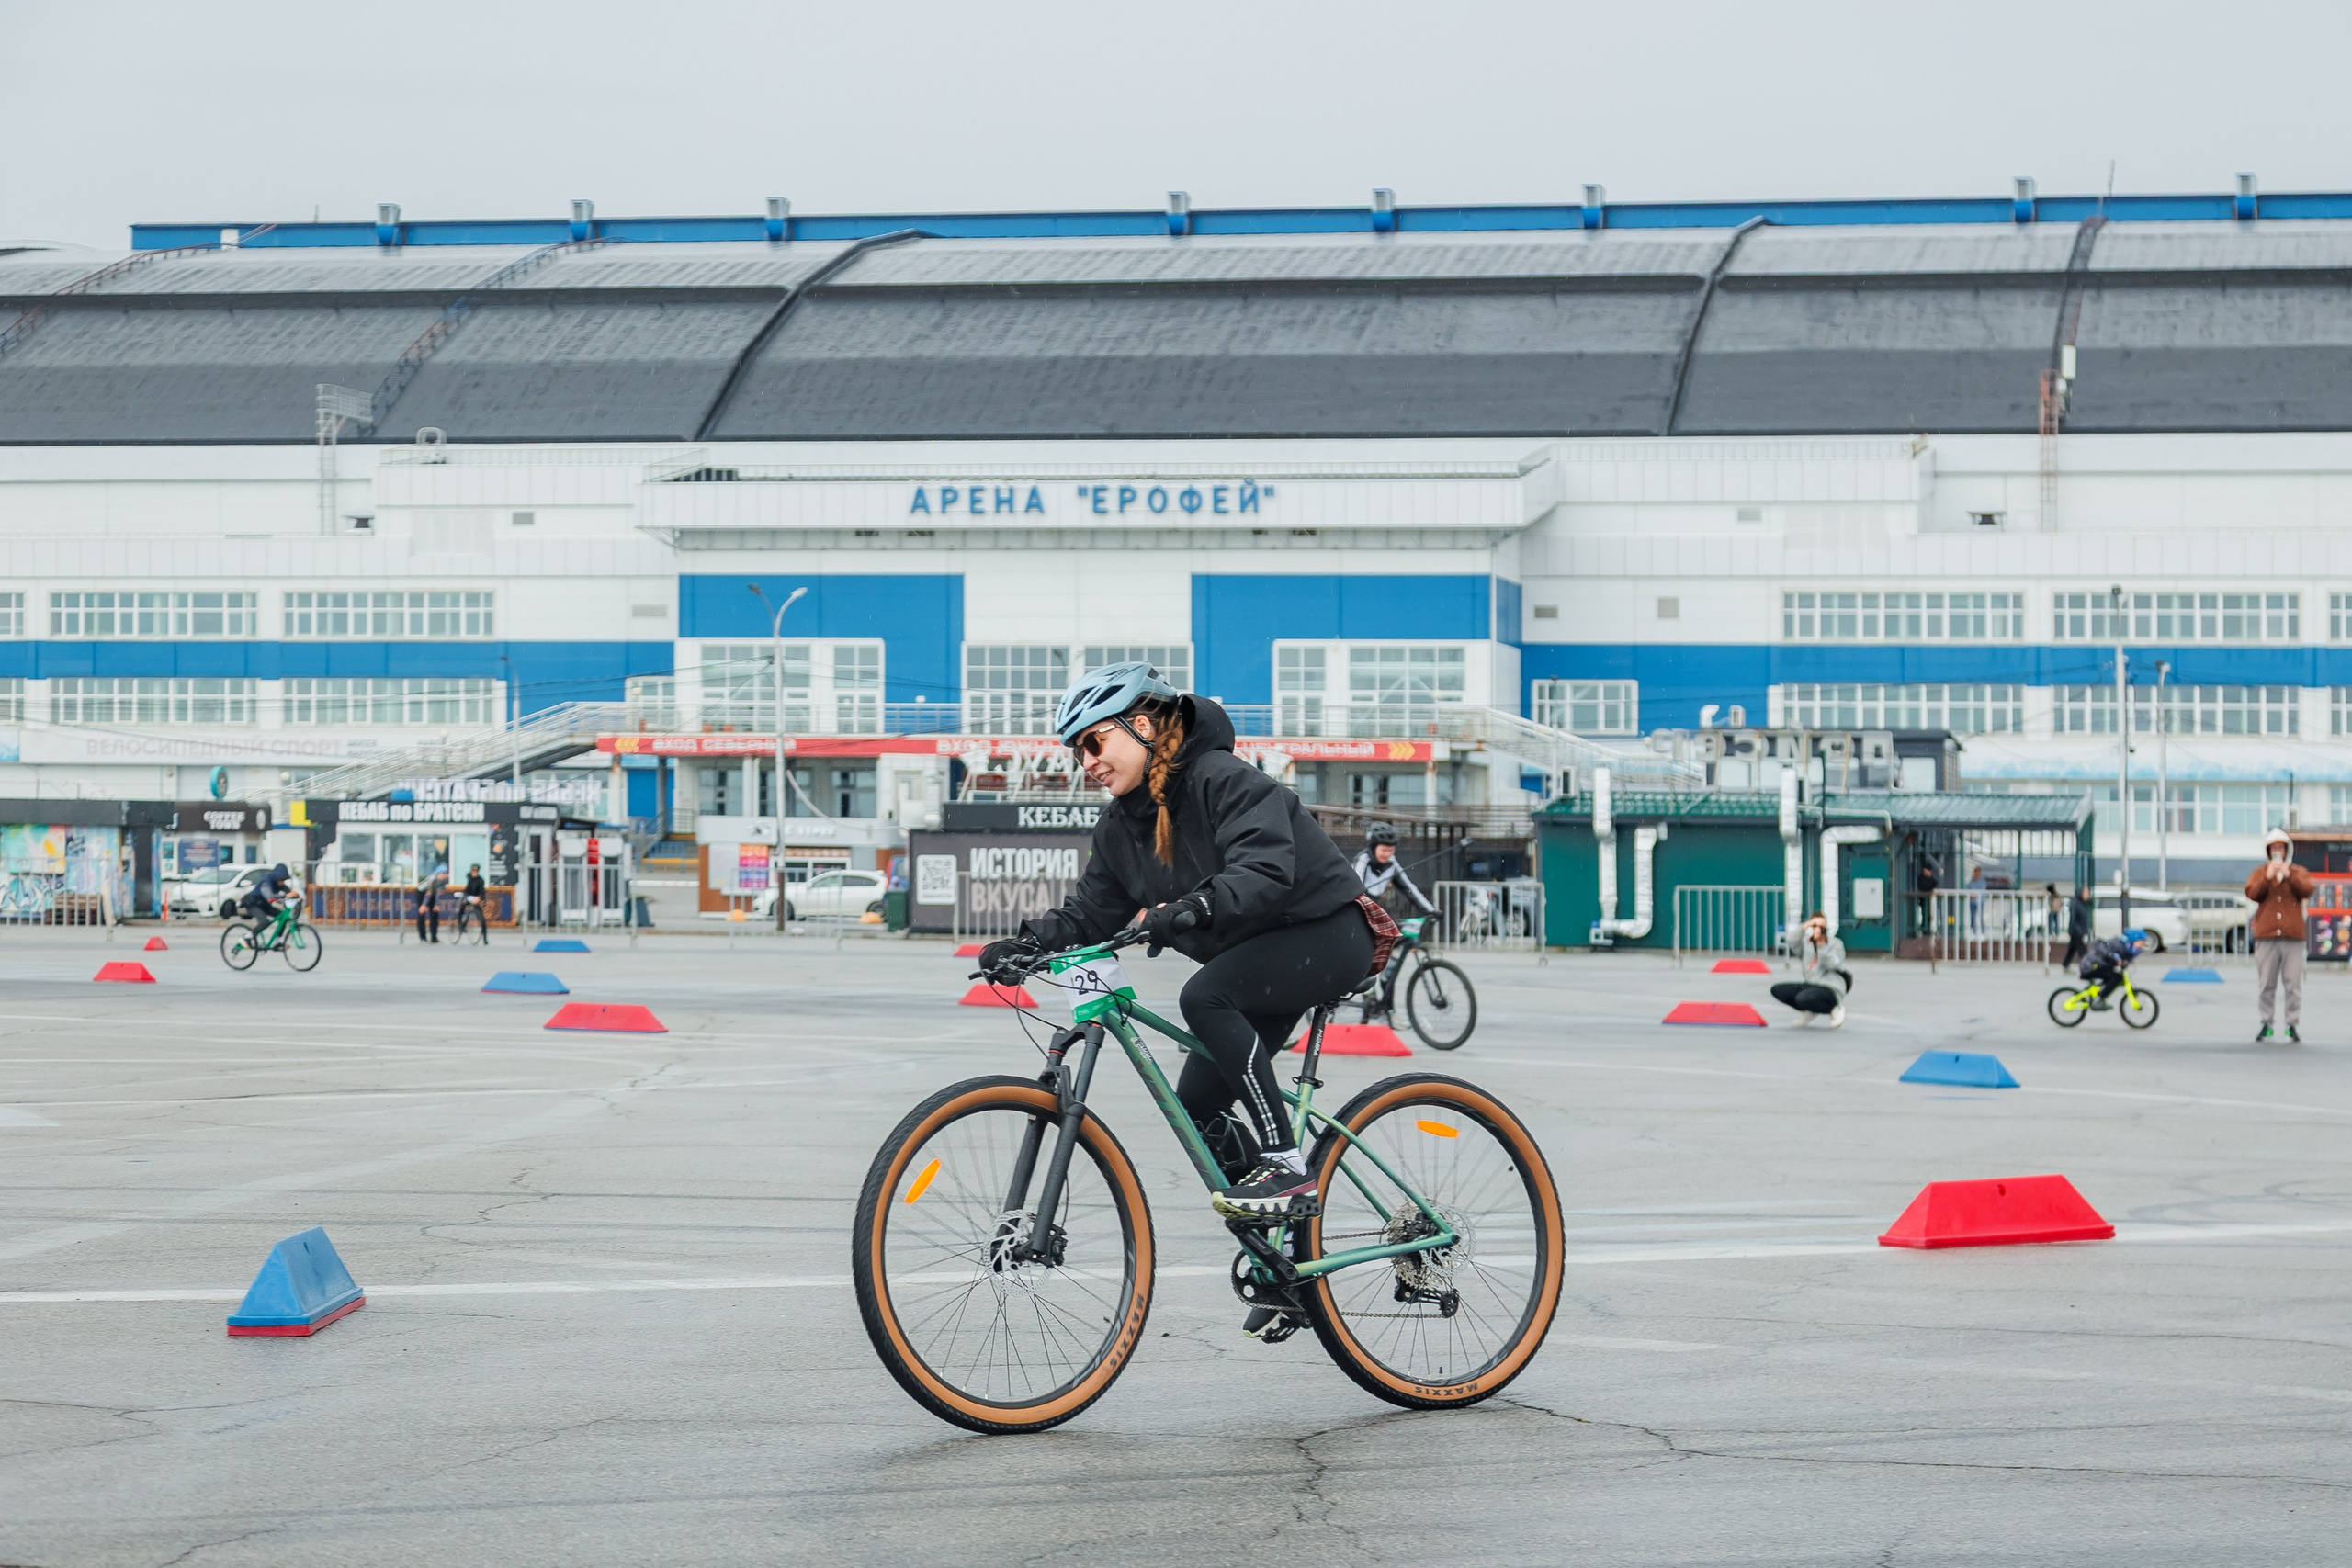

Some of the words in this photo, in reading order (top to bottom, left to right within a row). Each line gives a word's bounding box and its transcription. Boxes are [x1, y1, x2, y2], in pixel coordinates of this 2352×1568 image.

[910, 485, 1045, 514] АРЕНА
[1077, 479, 1275, 514] "ЕРОФЕЙ"
[86, 736, 264, 758] ВЕЛОСИПЕДНЫЙ
[271, 739, 341, 756] СПОРТ
[203, 811, 245, 822] COFFEE
[339, 802, 389, 820] КЕБАБ
[390, 806, 412, 821] по
[413, 802, 485, 821] БРАТСКИ
[1018, 807, 1101, 827] КЕБАБ
[209, 821, 241, 830] TOWN
[970, 847, 1079, 879] ИСТОРИЯ
[971, 882, 1050, 913] ВКУСА
[1109, 1292, 1145, 1369] MAXXIS
[1415, 1382, 1478, 1396] MAXXIS
